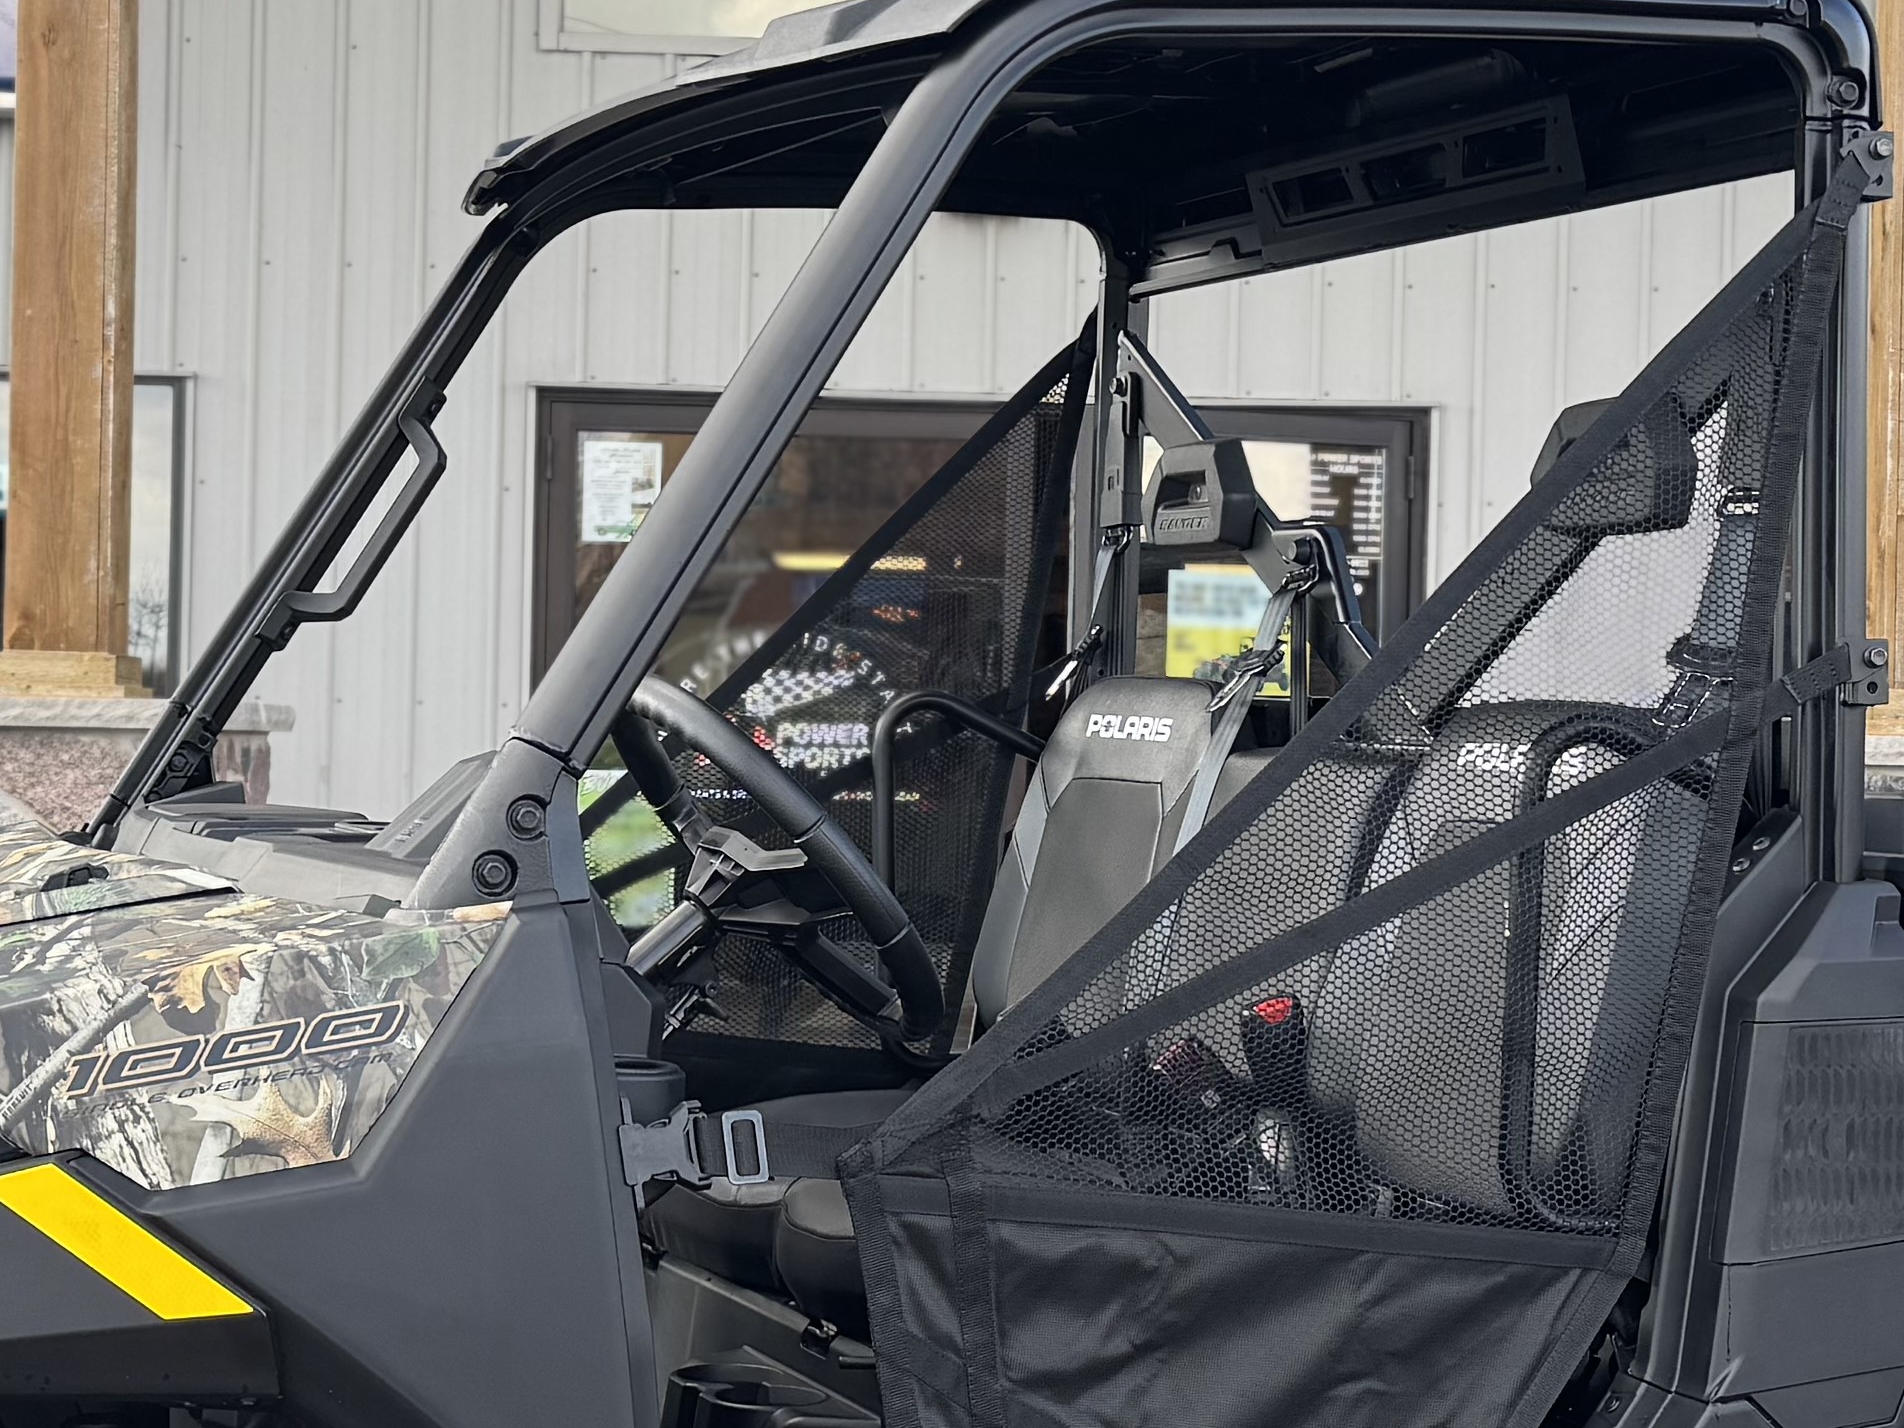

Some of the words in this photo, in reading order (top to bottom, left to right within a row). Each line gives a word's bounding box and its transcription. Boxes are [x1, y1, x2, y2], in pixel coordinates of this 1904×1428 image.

[1085, 713, 1174, 743] POLARIS
[65, 1000, 411, 1100] 1000
[177, 1062, 325, 1099] OVERHEAD
